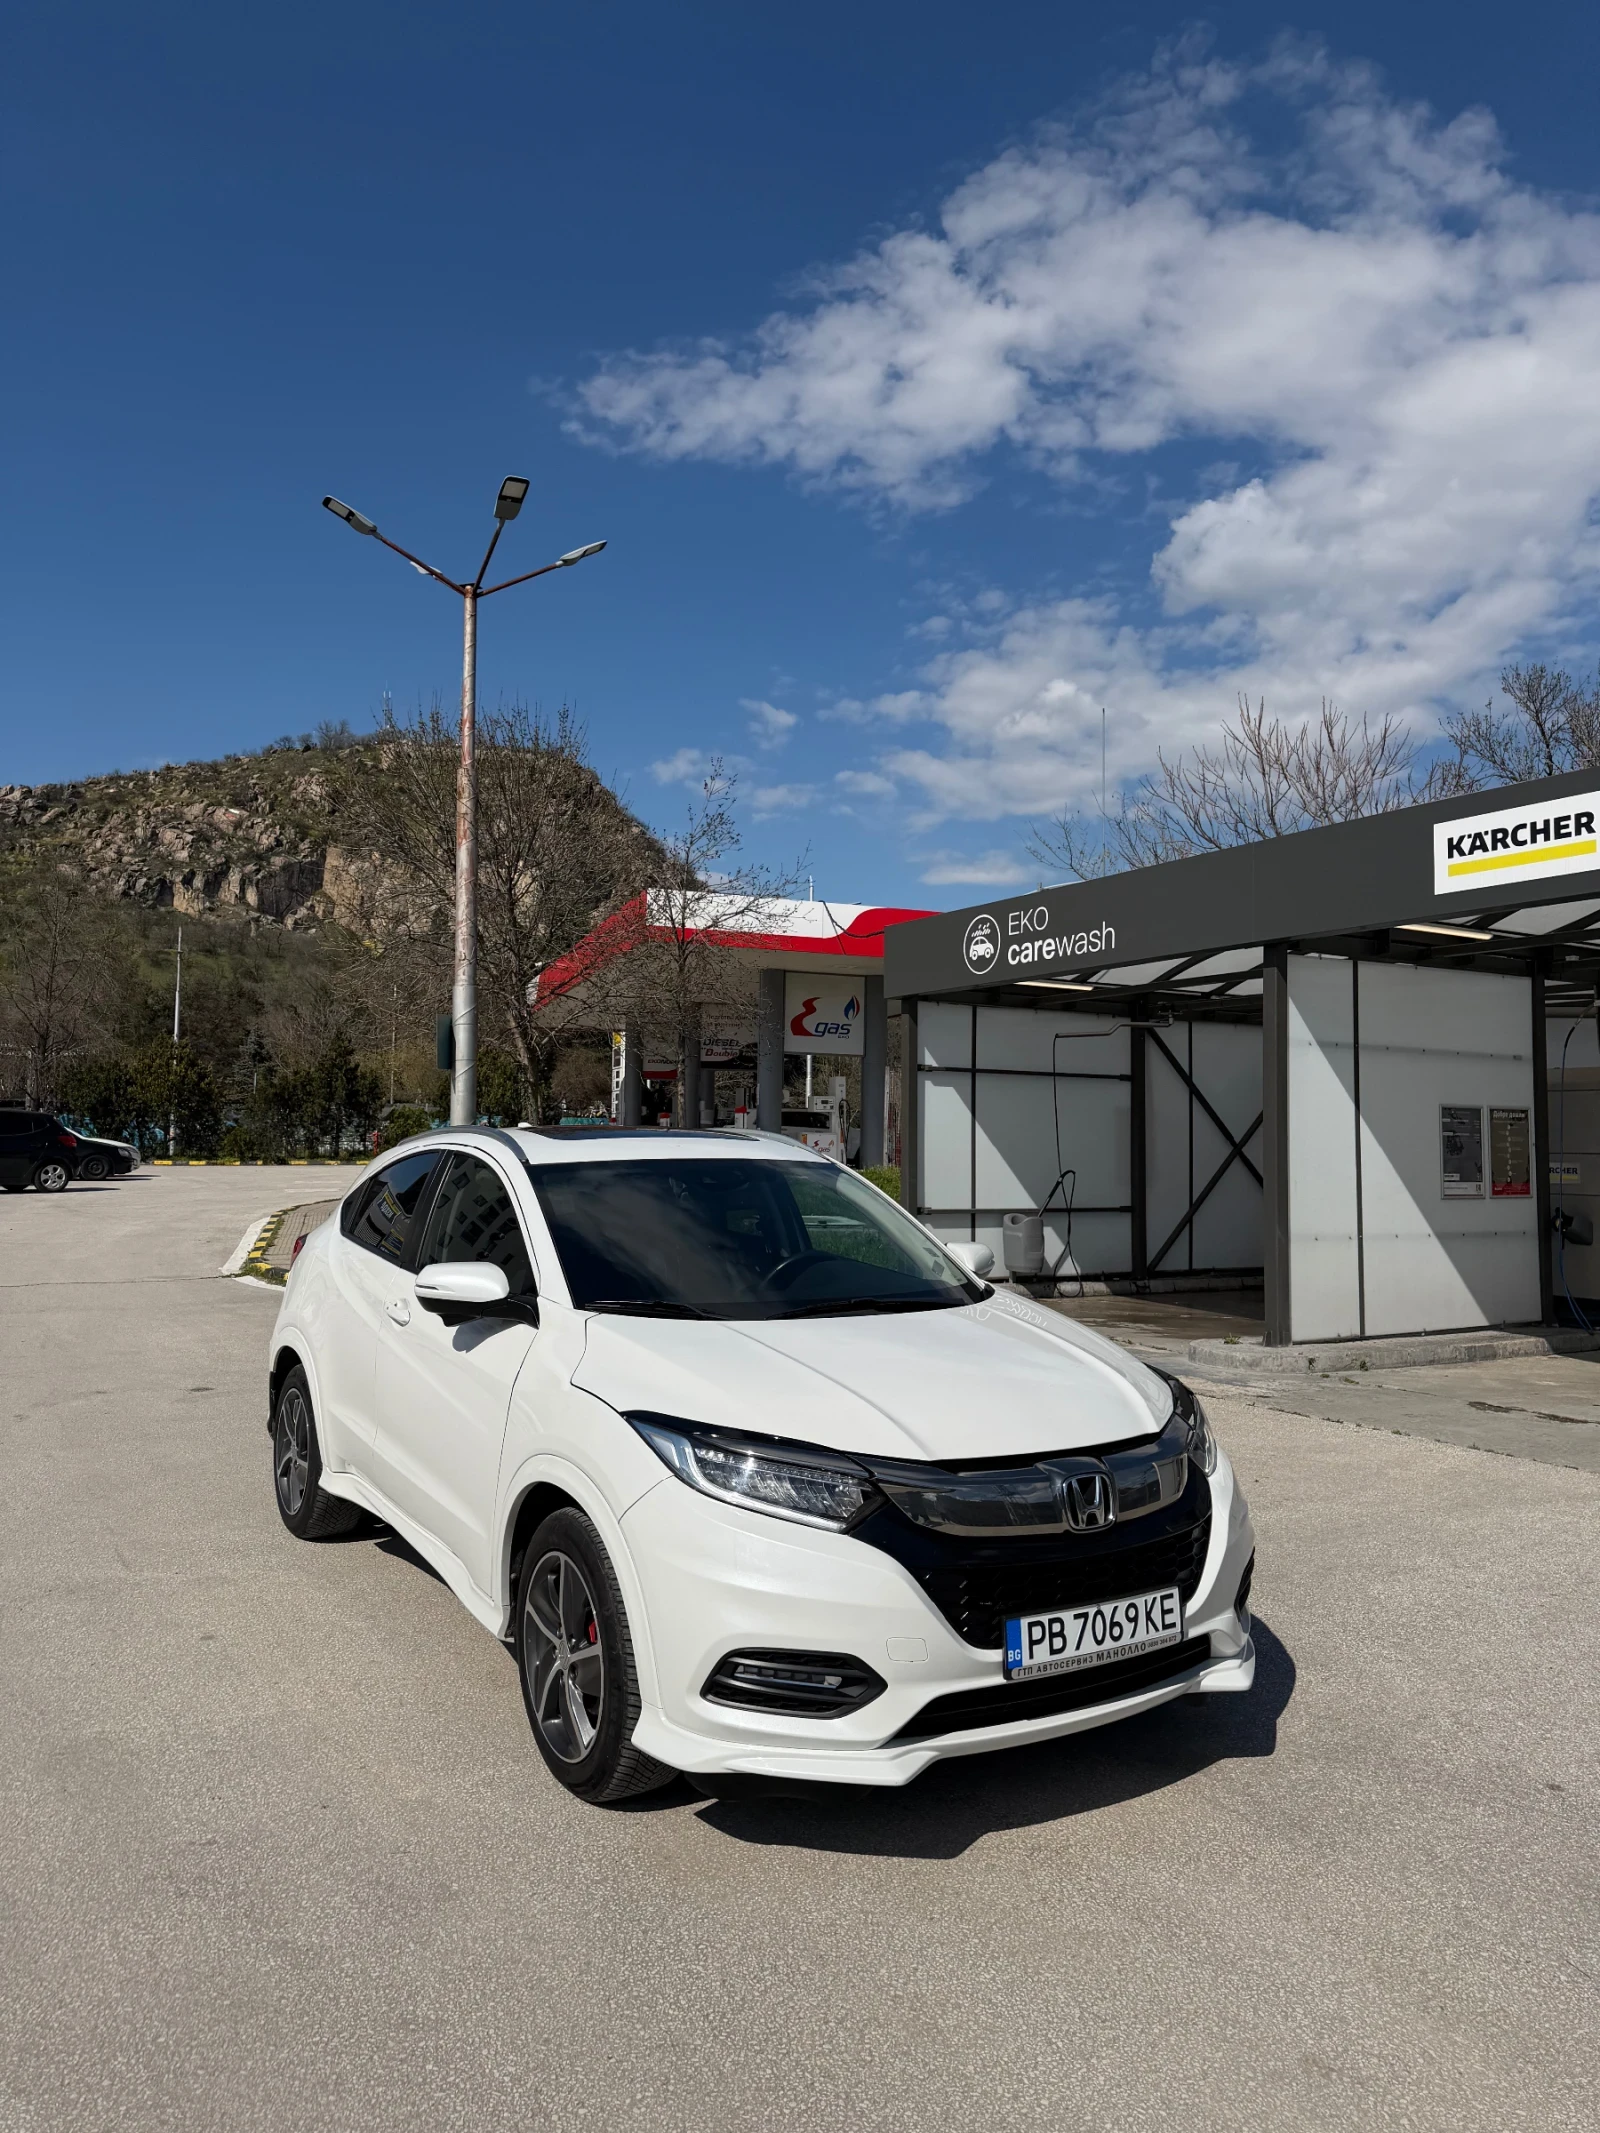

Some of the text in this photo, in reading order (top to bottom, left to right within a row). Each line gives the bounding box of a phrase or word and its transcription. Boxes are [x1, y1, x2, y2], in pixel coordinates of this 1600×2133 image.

[1447, 811, 1597, 859] KÄRCHER
[1008, 906, 1049, 936] EKO
[1008, 921, 1116, 965] carewash
[1008, 1649, 1021, 1662] BG
[1017, 1666, 1033, 1677] ГТП
[1037, 1654, 1094, 1673] АВТОСЕРВИЗ
[1096, 1642, 1147, 1663] МАНОЛЛО
